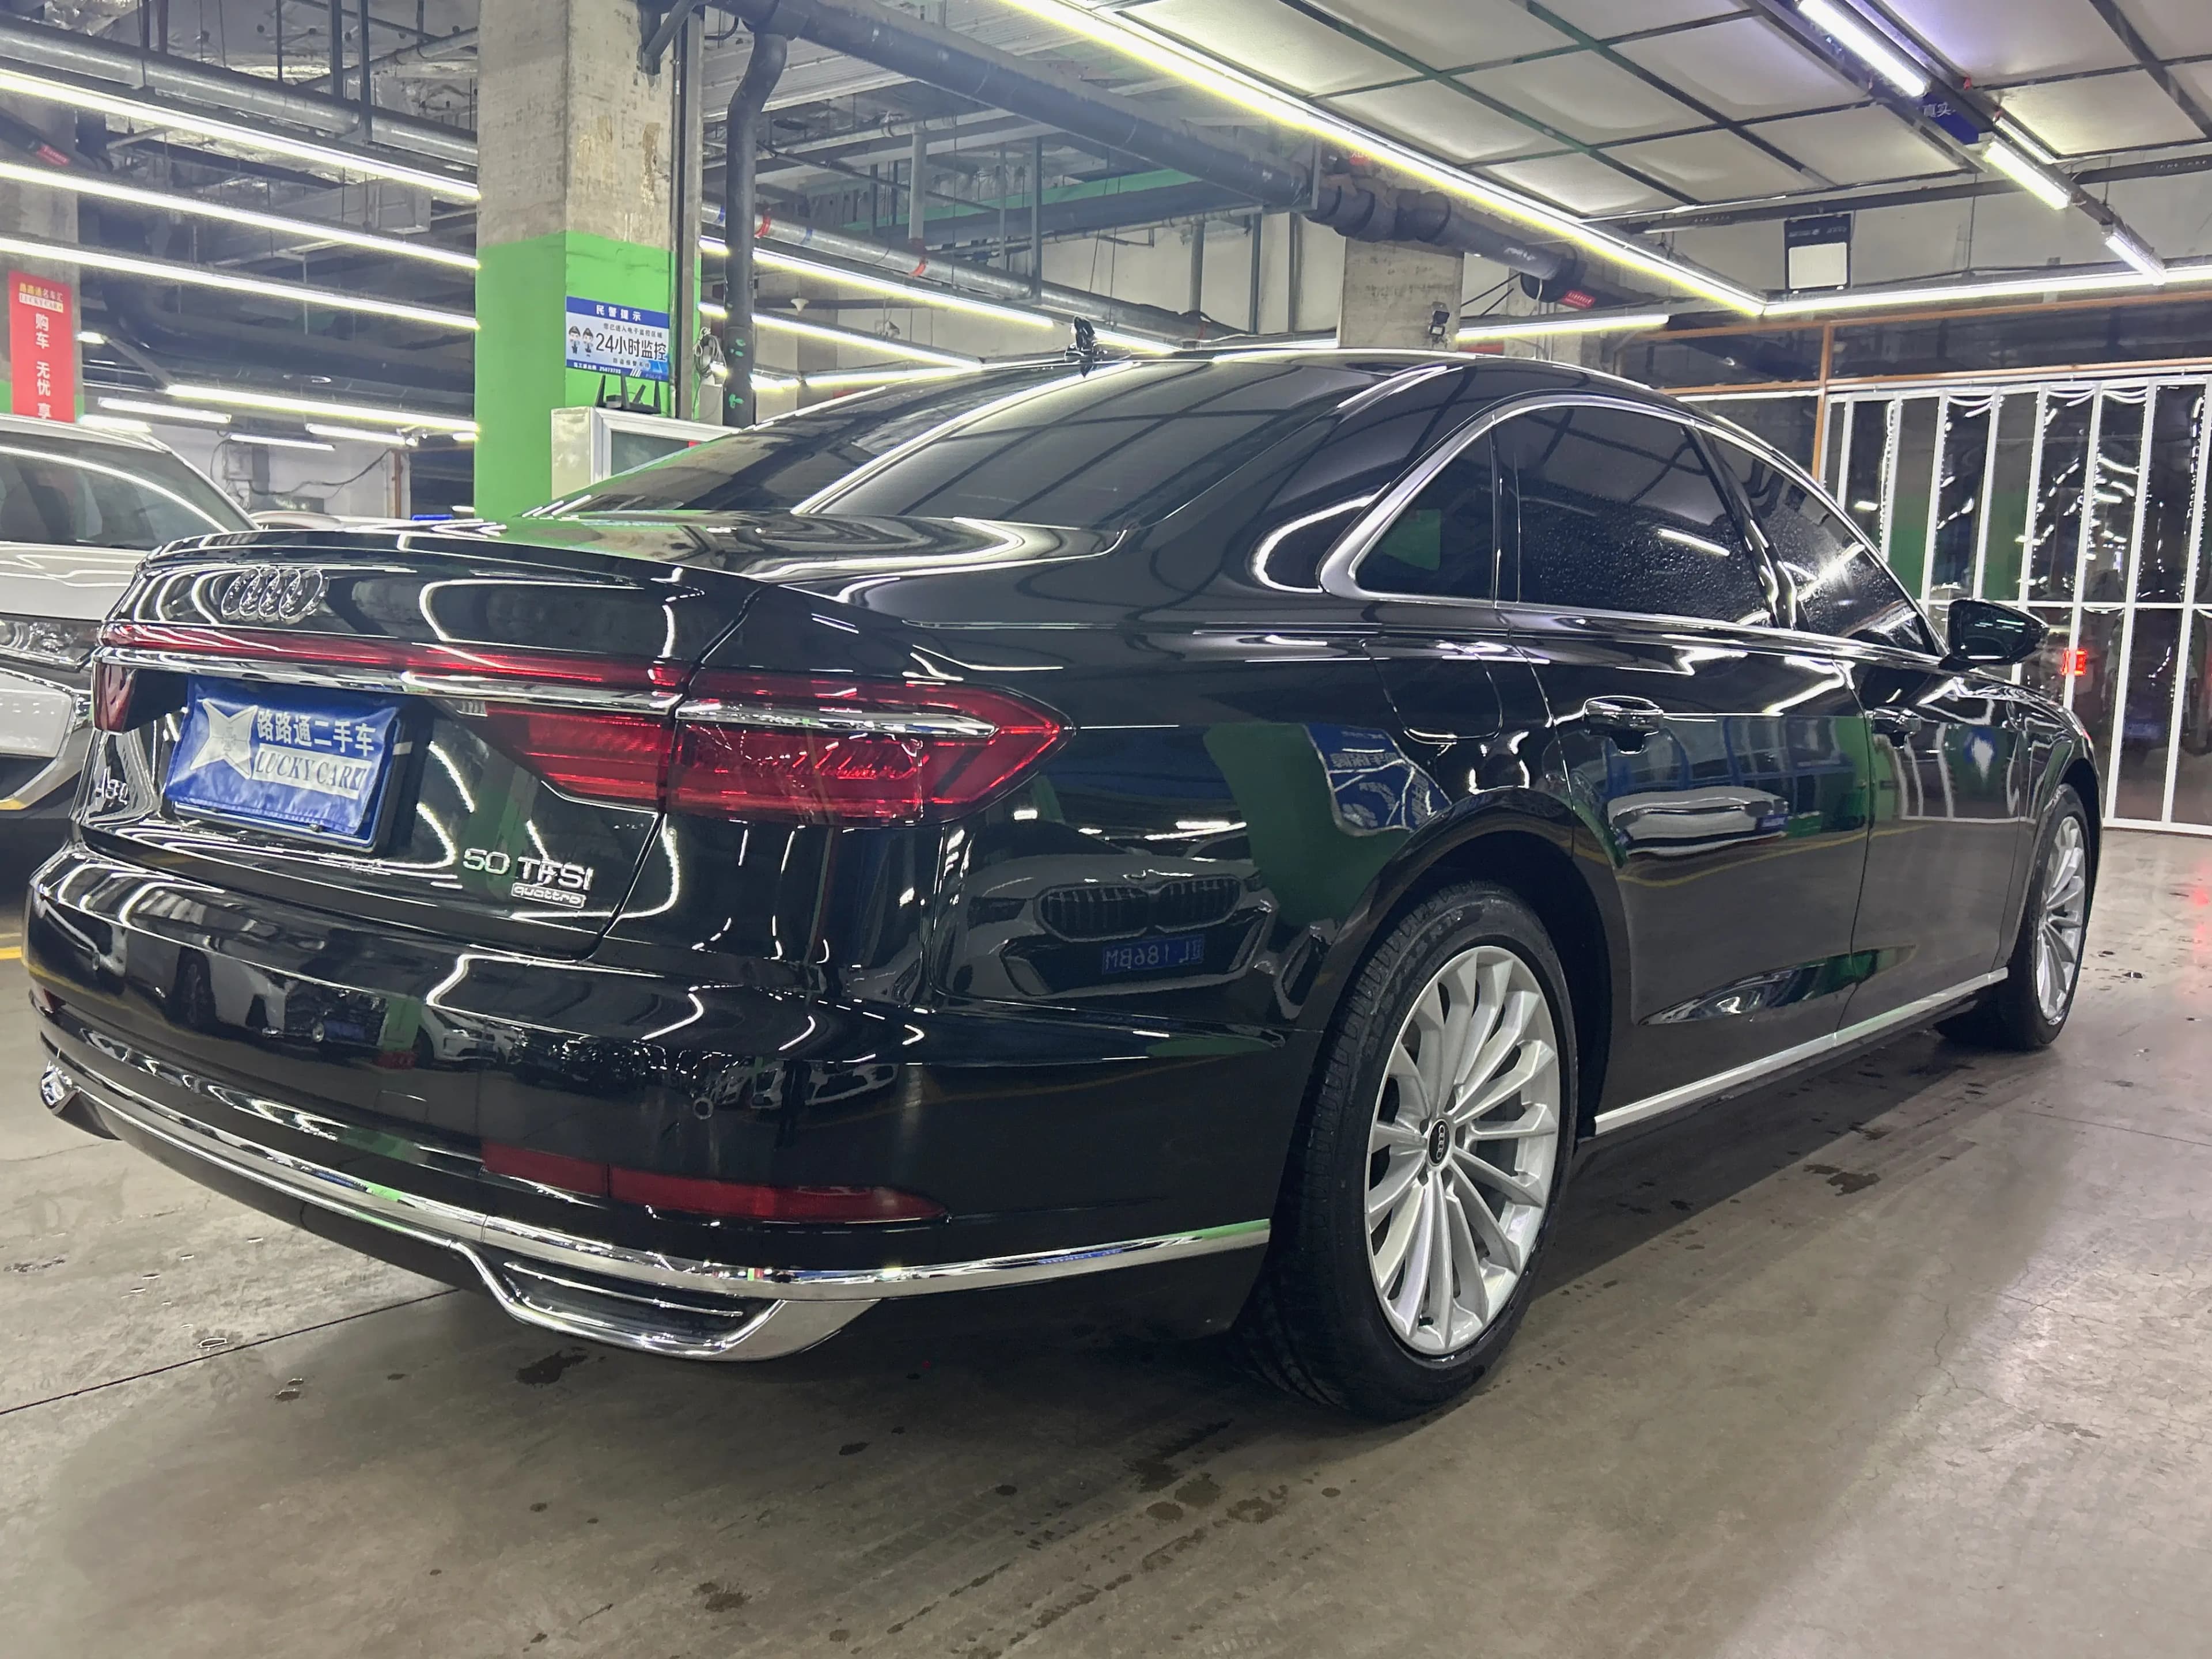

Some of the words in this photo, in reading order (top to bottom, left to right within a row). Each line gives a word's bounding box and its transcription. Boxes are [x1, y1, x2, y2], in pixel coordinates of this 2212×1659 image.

[596, 332, 666, 361] 24小时监控
[257, 709, 376, 757] 路路通二手车
[255, 751, 315, 781] LUCKY
[463, 847, 511, 876] 50
[517, 856, 594, 891] TFSI
[514, 885, 581, 905] quattro
